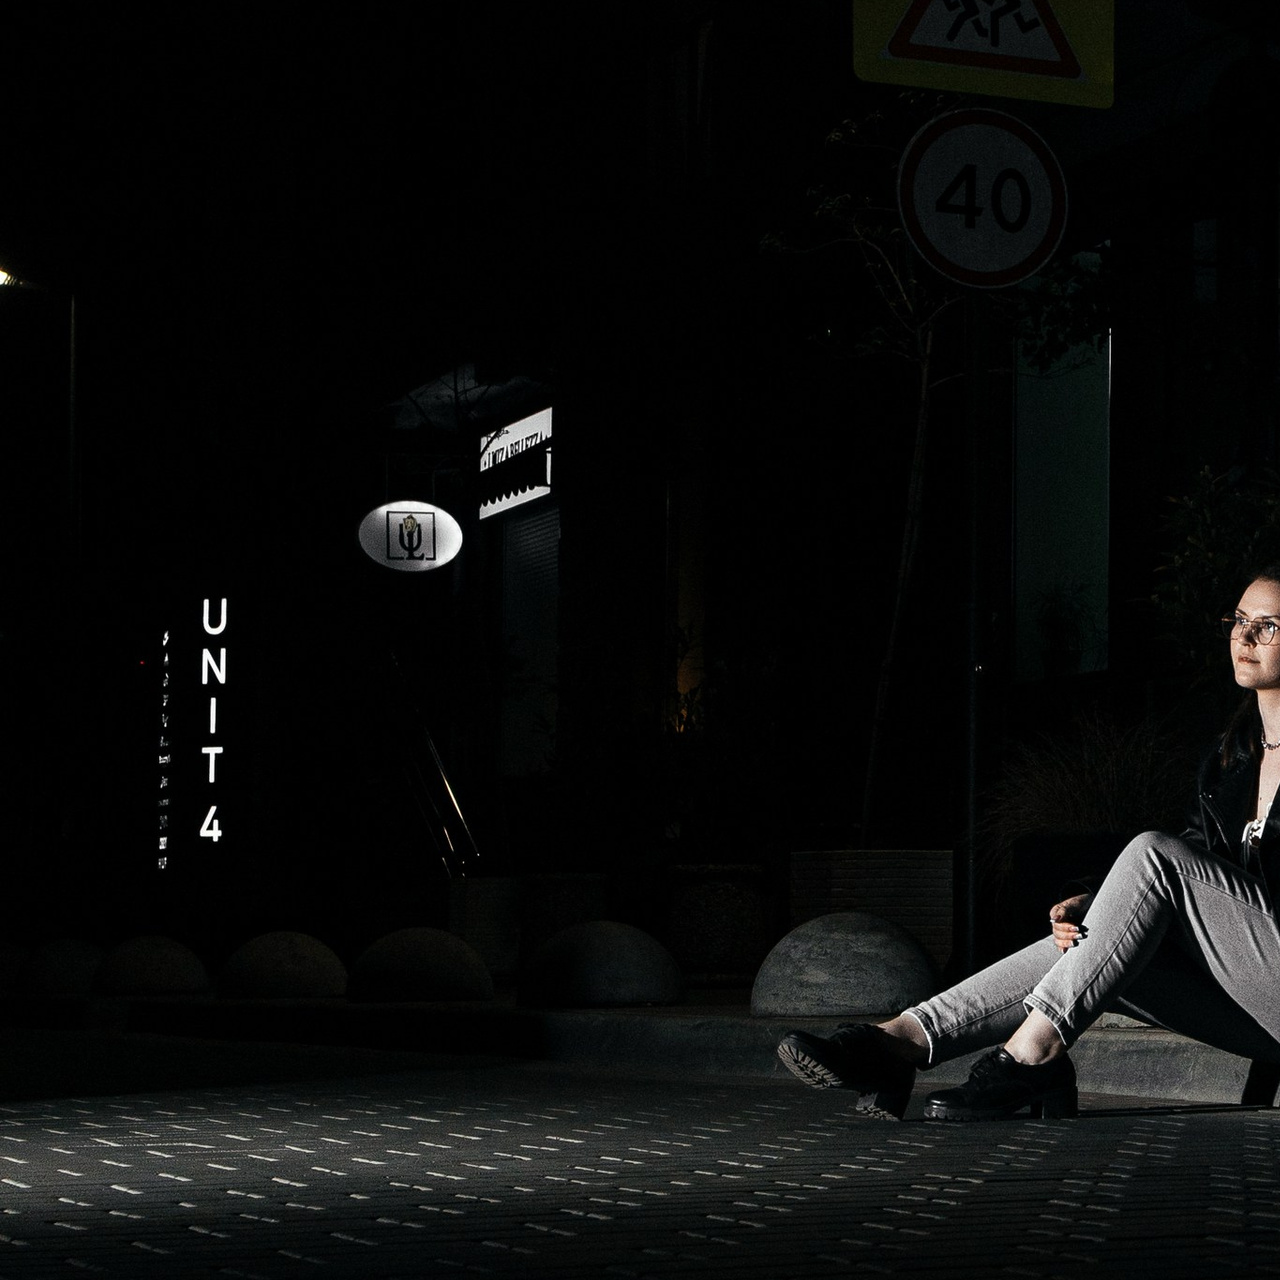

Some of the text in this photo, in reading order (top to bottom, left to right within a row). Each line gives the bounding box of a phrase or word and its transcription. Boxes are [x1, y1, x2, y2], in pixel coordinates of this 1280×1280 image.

[935, 164, 1031, 233] 40
[200, 598, 227, 842] UNIT 4
